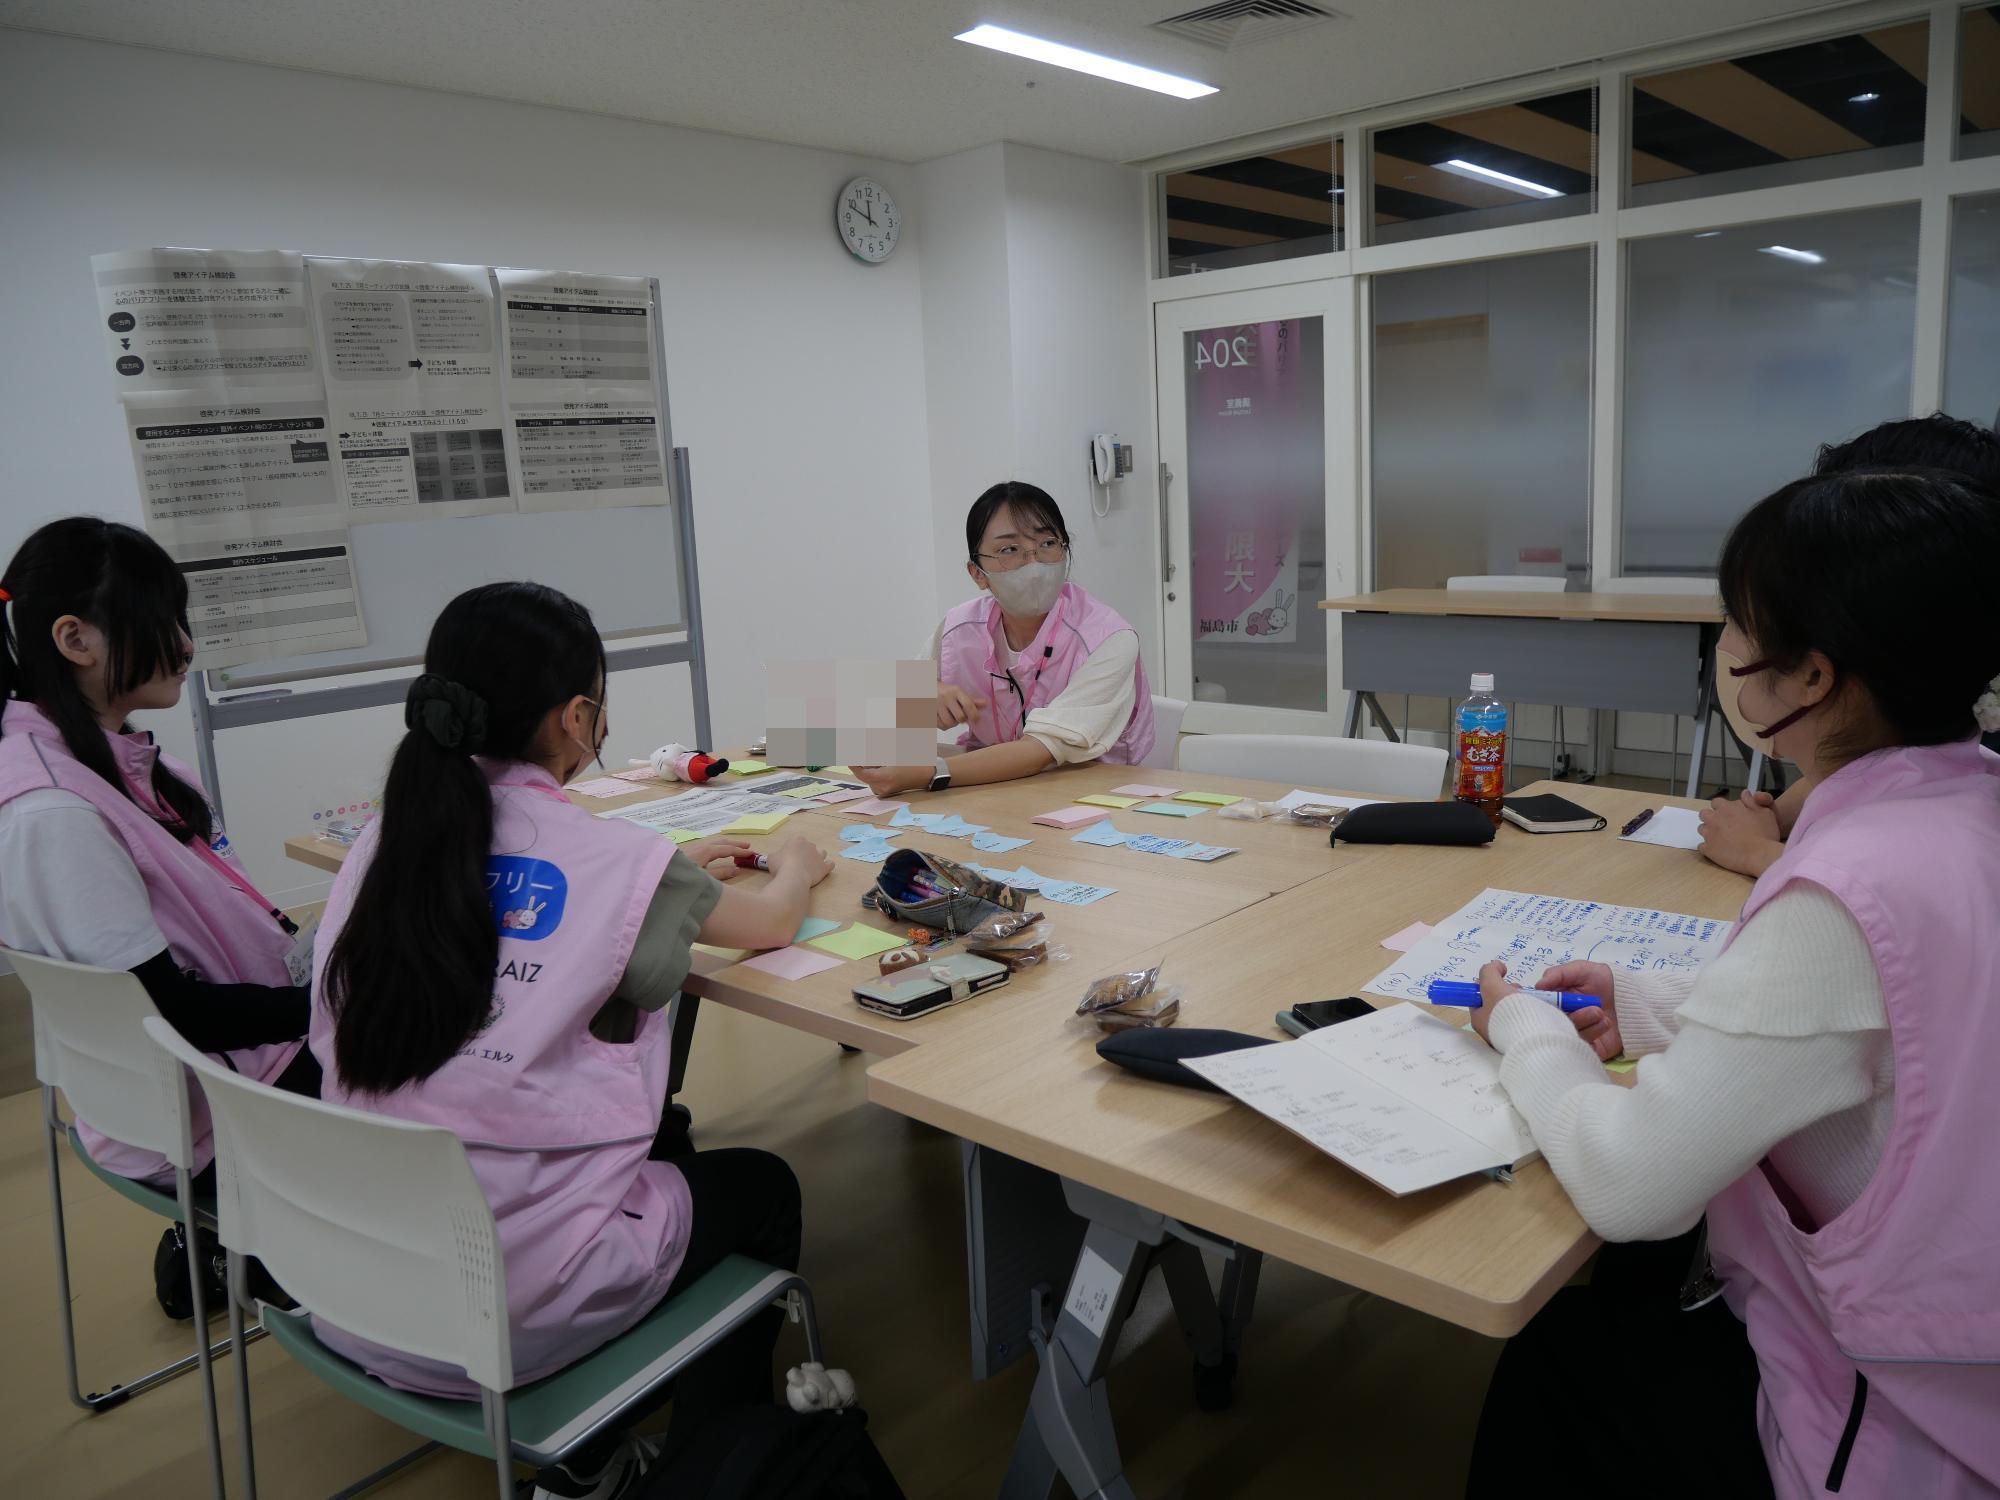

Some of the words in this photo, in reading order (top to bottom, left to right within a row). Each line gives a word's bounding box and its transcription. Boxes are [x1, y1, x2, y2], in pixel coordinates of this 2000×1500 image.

[855, 189, 862, 200] 11
[864, 187, 873, 198] 12
[876, 192, 881, 202] 1
[884, 203, 890, 214] 2
[845, 212, 851, 223] 9
[888, 218, 893, 228] 3
[849, 227, 855, 237] 8
[885, 231, 891, 241] 4
[858, 238, 863, 248] 7
[868, 243, 874, 253] 6
[879, 241, 884, 251] 5
[1200, 618, 1239, 633] 福島市
[1466, 746, 1500, 763] むぎ茶
[486, 871, 553, 893] フリー
[494, 959, 543, 983] AIZ
